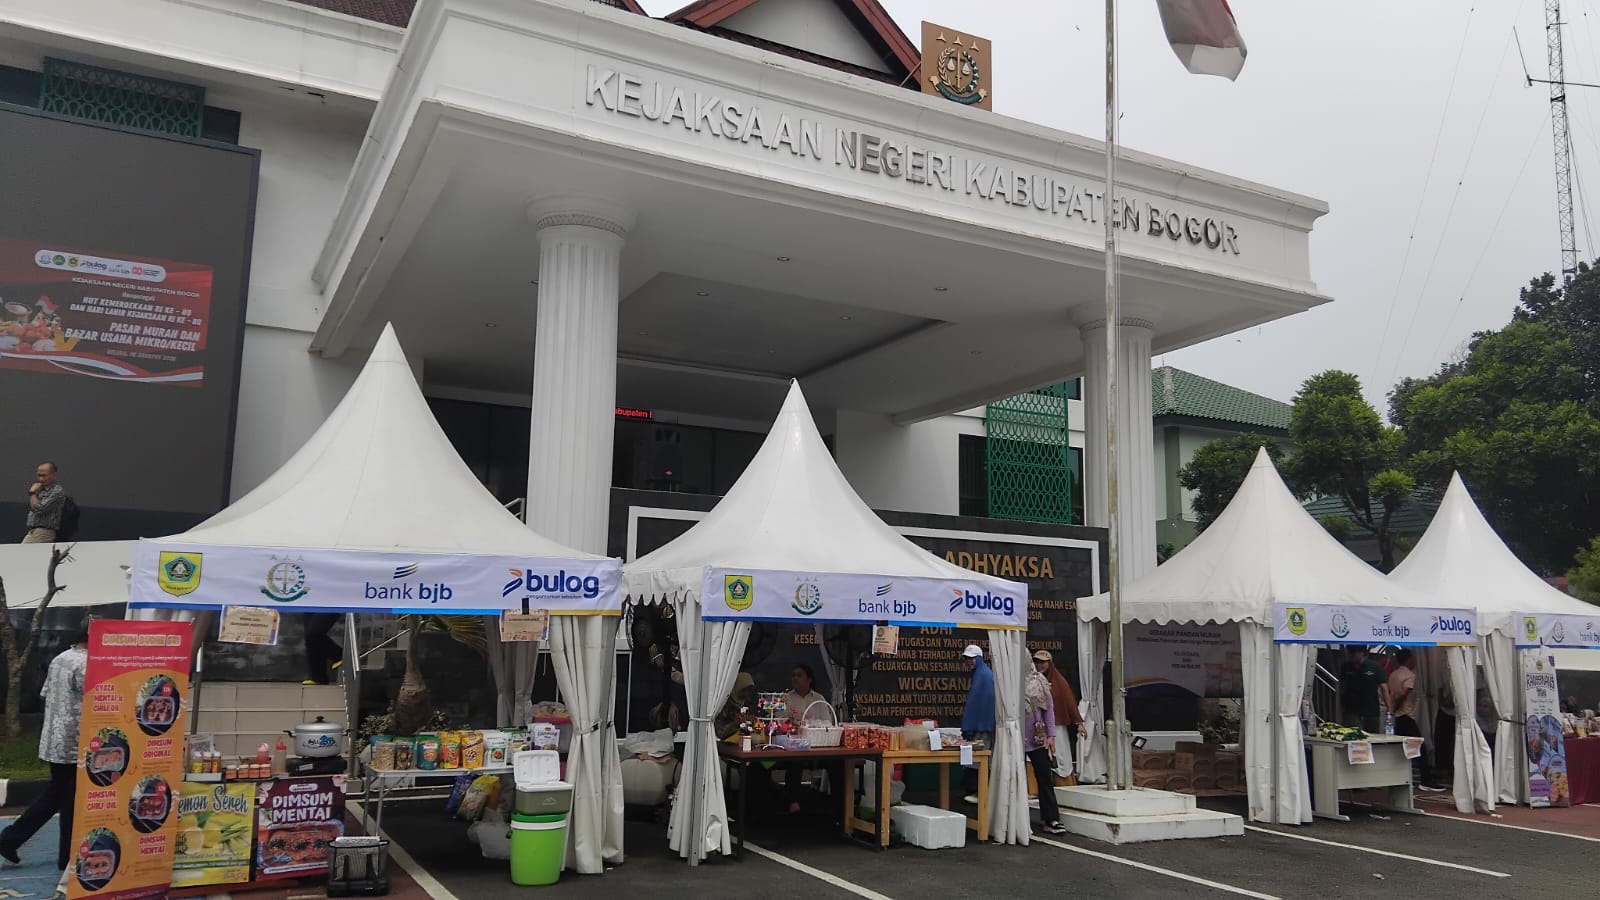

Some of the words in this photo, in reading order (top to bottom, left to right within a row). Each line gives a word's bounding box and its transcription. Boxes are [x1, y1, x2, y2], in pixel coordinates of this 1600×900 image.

[585, 64, 823, 160] KEJAKSAAN
[835, 127, 956, 190] NEGERI
[965, 159, 1140, 232] KABUPATEN
[1147, 203, 1241, 255] BOGOR
[82, 296, 99, 304] HUT
[100, 298, 154, 311] KEMERDEKAAN
[87, 305, 104, 314] HARI
[105, 307, 126, 317] LAHIR
[126, 309, 167, 322] KEJAKSAAN
[109, 322, 142, 335] PASAR
[142, 326, 178, 338] MURAH
[179, 330, 201, 342] DAN
[64, 328, 98, 341] BAZAR
[100, 332, 132, 345] USAHA
[134, 336, 197, 352] MIKRO/KECIL
[945, 550, 1055, 579] ADHYAKSA
[364, 581, 413, 600] bank
[418, 582, 453, 604] bjb
[526, 569, 600, 599] bulog
[858, 598, 890, 615] bank
[893, 599, 917, 617] bjb
[965, 590, 1015, 616] bulog
[1044, 600, 1064, 609] MAHA
[1372, 625, 1393, 637] bank
[1394, 625, 1410, 639] bjb
[1438, 615, 1472, 635] bulog
[926, 638, 942, 648] DAN
[943, 638, 963, 648] YANG
[919, 650, 956, 660] TERHADAP
[872, 662, 912, 671] KELUARGA
[914, 662, 929, 672] DAN
[930, 662, 960, 672] SESAMA
[885, 694, 912, 704] DALAM
[913, 694, 938, 704] TUTUR
[939, 694, 956, 704] KATA
[861, 706, 889, 717] DALAM
[890, 706, 941, 717] PENGETRAPAN
[146, 738, 173, 747] DIMSUM
[143, 750, 172, 759] ORIGINAL
[87, 790, 116, 799] DIMSUM
[178, 795, 208, 819] emon
[212, 785, 249, 815] Sereh
[272, 791, 334, 808] DIMSUM
[273, 807, 332, 822] MENTAI
[139, 835, 166, 844] DIMSUM
[140, 846, 165, 855] MENTAI
